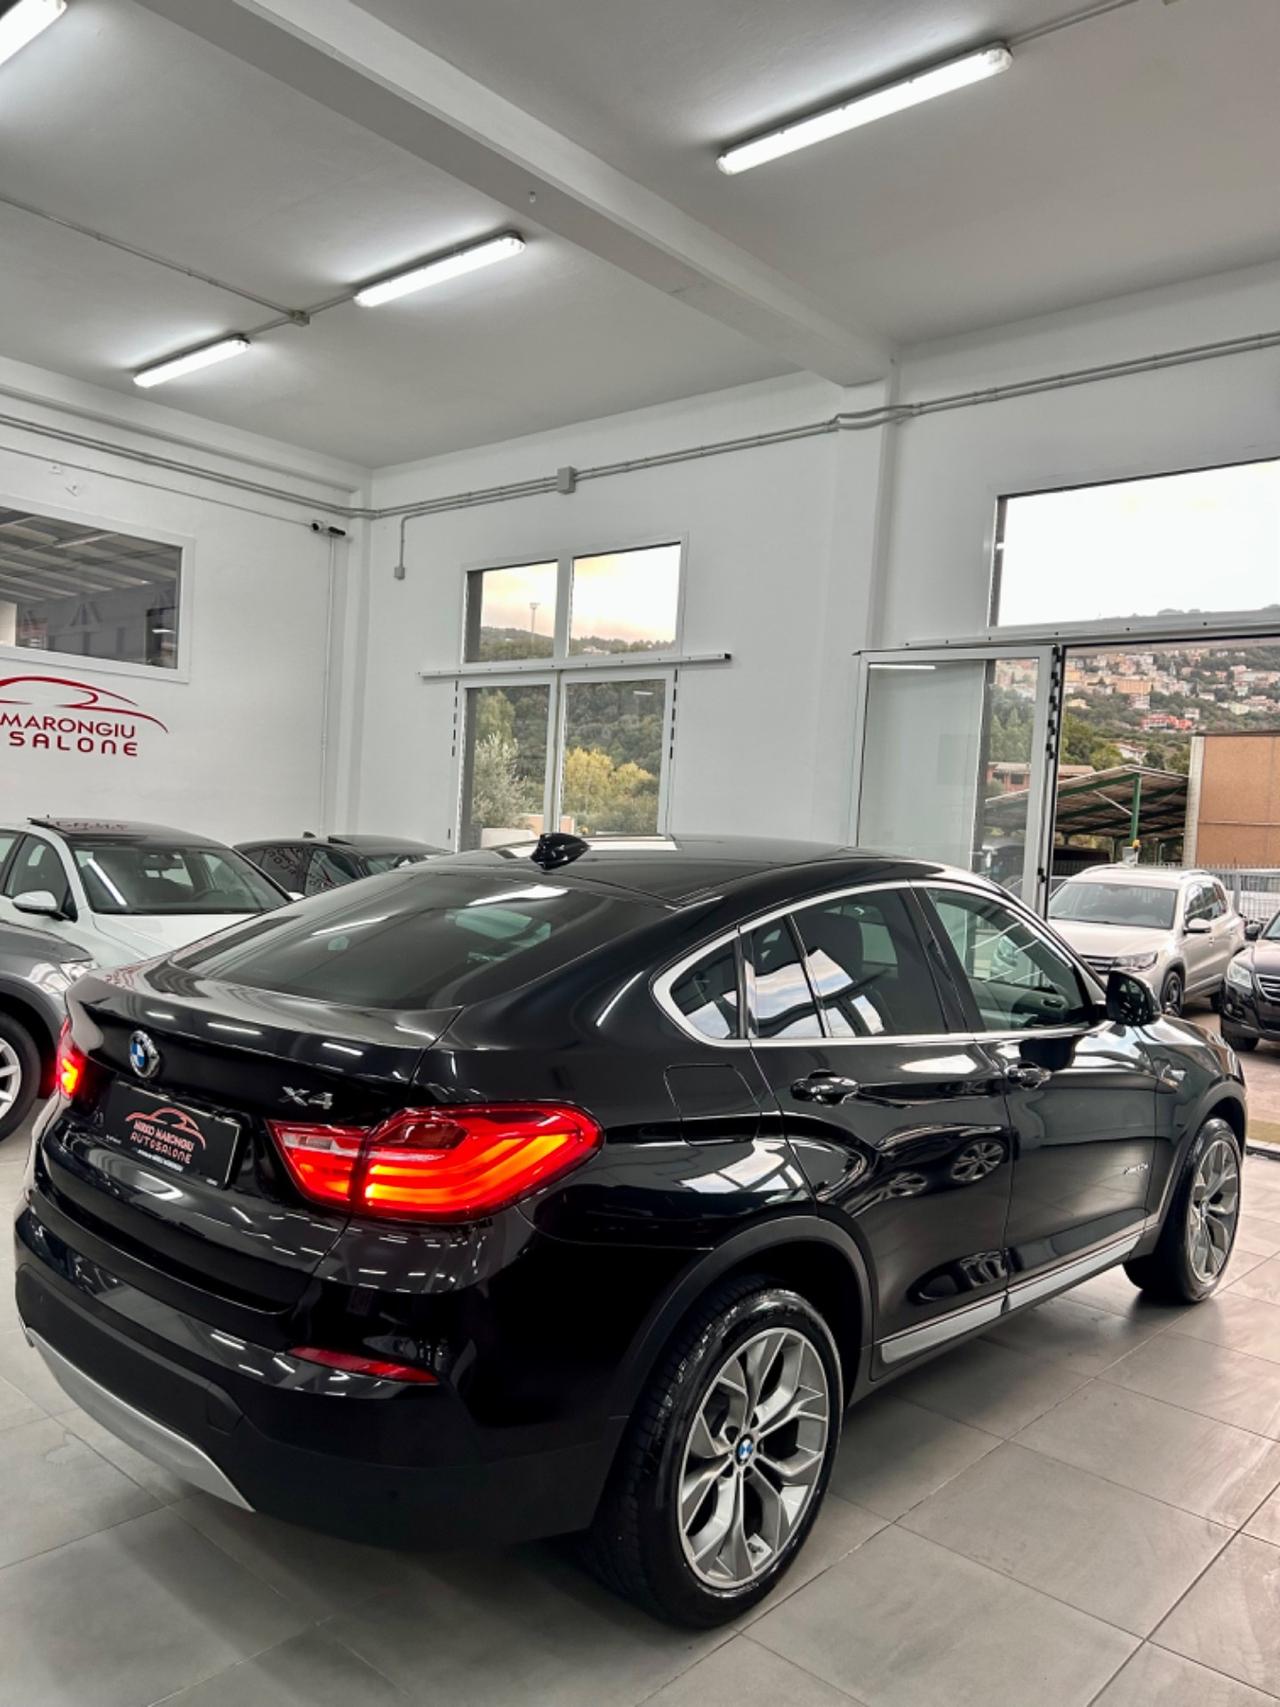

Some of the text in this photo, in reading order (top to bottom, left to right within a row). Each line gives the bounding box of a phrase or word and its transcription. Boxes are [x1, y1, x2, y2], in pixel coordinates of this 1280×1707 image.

[0, 711, 136, 739] MARONGIU
[8, 730, 138, 757] SALONE
[279, 1086, 333, 1110] X4
